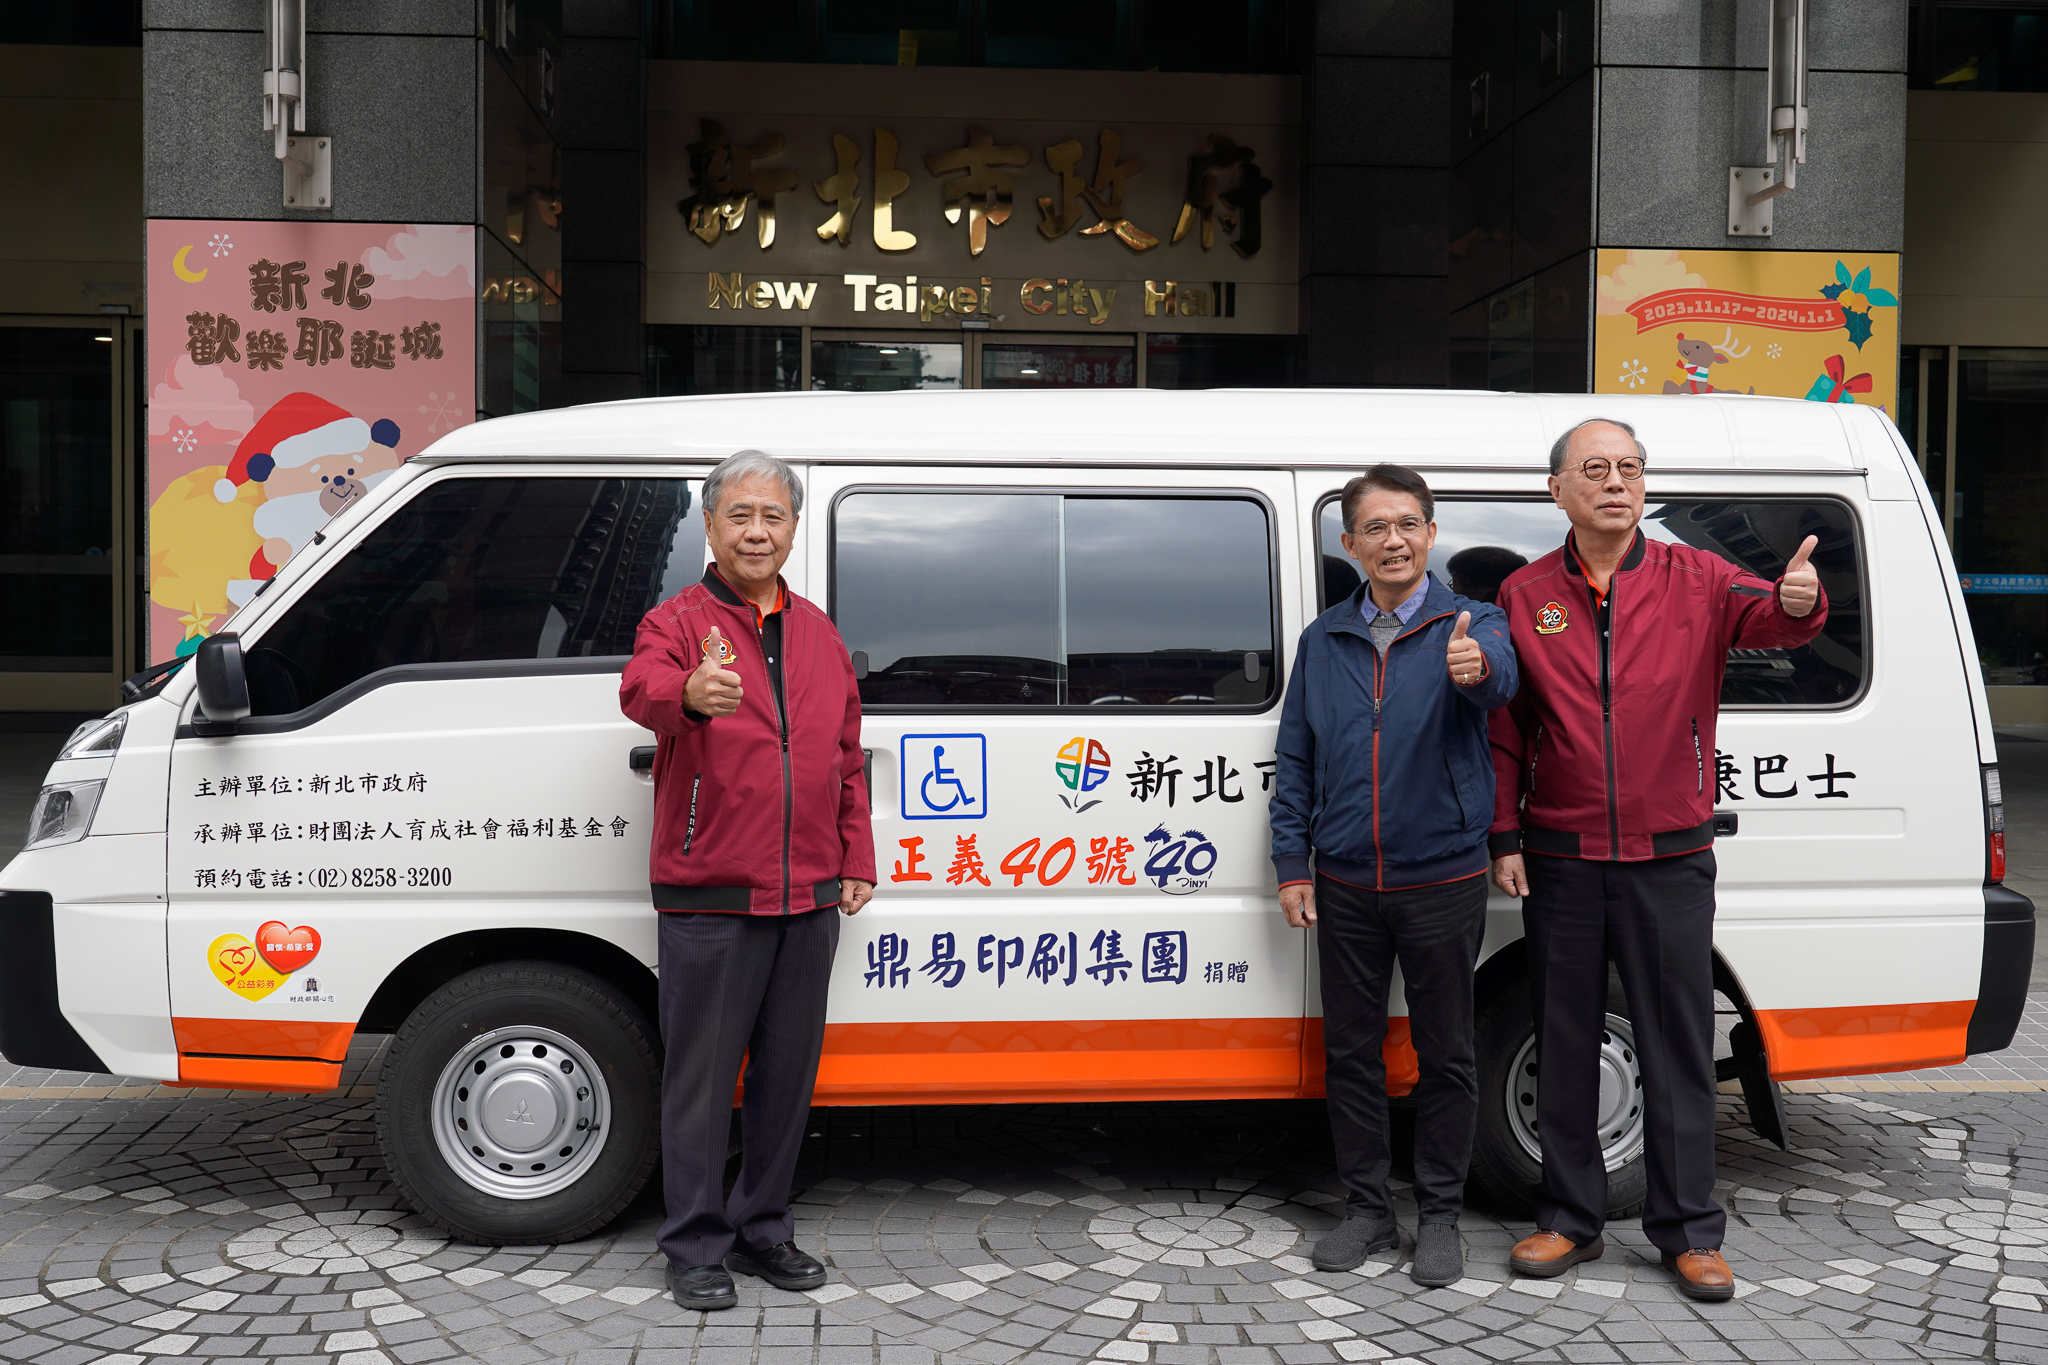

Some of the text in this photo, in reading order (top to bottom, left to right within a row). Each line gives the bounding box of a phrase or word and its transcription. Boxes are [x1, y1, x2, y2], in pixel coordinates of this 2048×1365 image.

[679, 117, 1273, 258] 新北市政府
[248, 258, 375, 313] 新北
[708, 272, 1235, 325] New Taipei City Hall
[1644, 300, 1835, 324] 2023.11.17~2024.1.1
[186, 310, 444, 371] 歡樂耶誕城
[890, 833, 1137, 887] 正義40號
[237, 979, 276, 989] 公益彩券
[865, 930, 1249, 989] 鼎易印刷集團 捐贈
